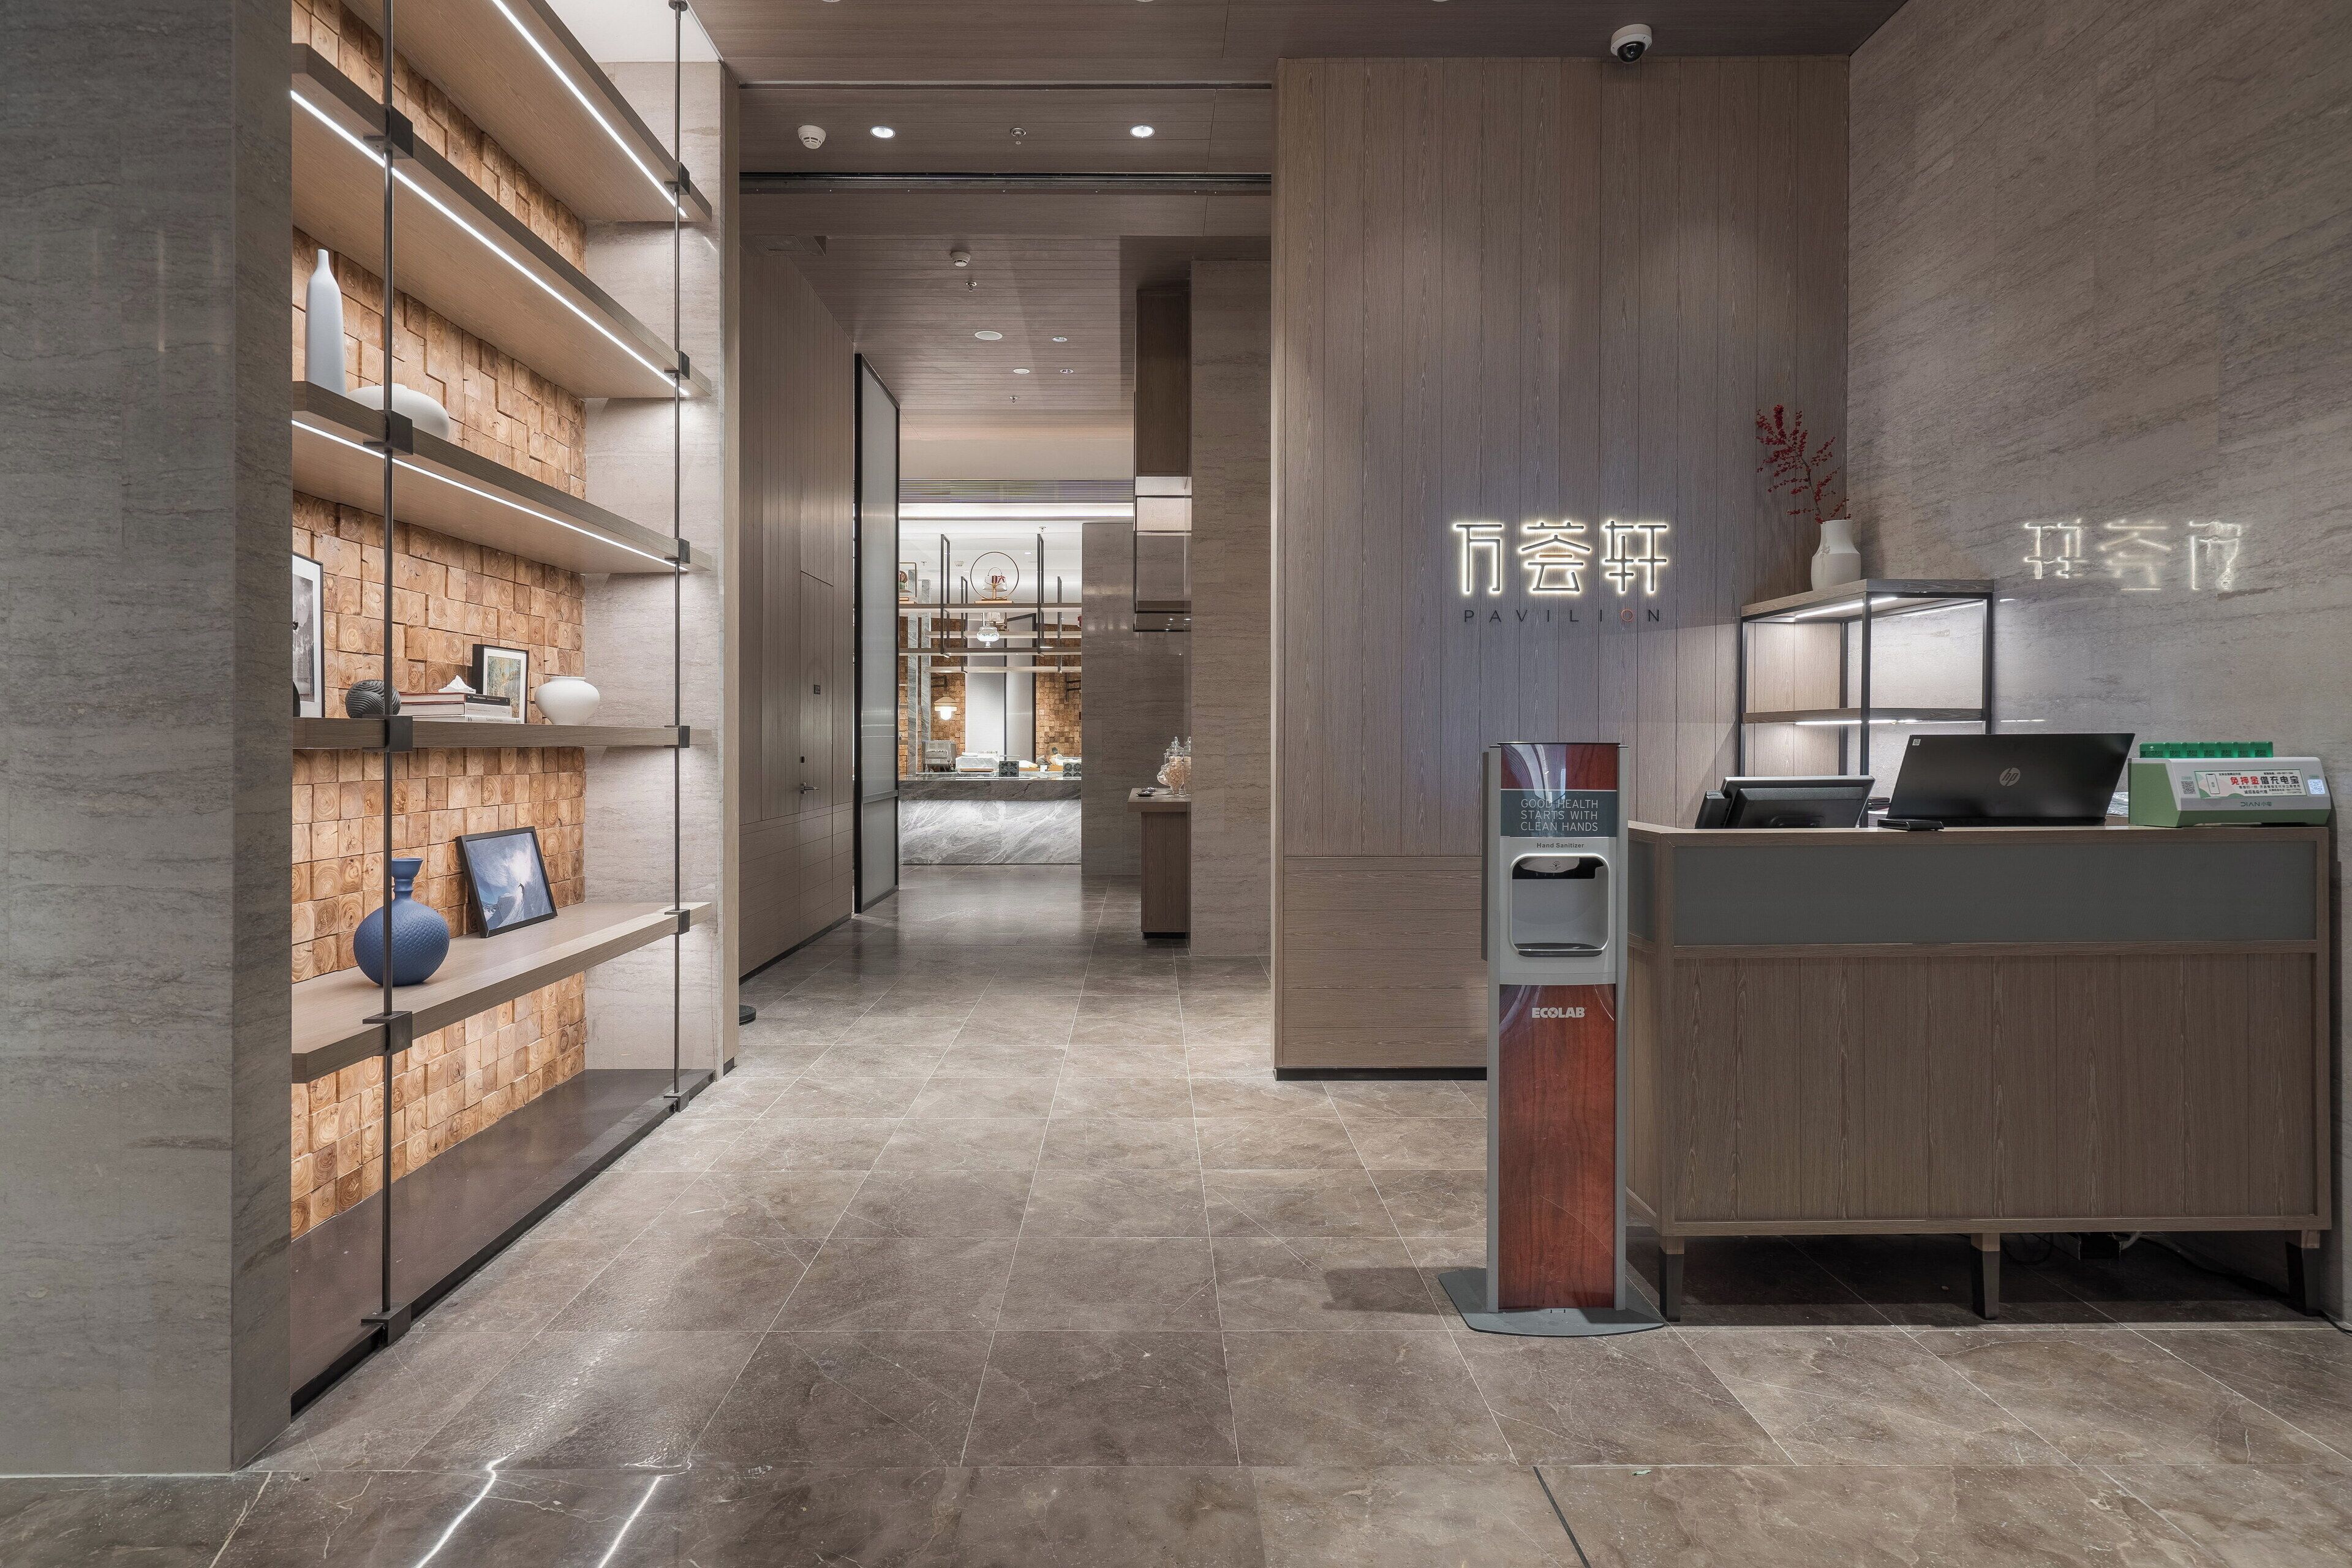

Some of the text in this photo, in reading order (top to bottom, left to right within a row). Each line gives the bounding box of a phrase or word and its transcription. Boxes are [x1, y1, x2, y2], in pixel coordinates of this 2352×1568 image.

[1454, 520, 1668, 593] 万荟轩
[1464, 609, 1660, 623] PAVILION
[2001, 767, 2020, 786] hp
[2230, 775, 2299, 785] 免押金借充电宝
[1521, 799, 1598, 809] GOOD HEALTH
[1521, 810, 1598, 820] STARTS WITH
[1521, 822, 1598, 831] CLEAN HANDS
[1531, 1007, 1585, 1019] ECOLAB
